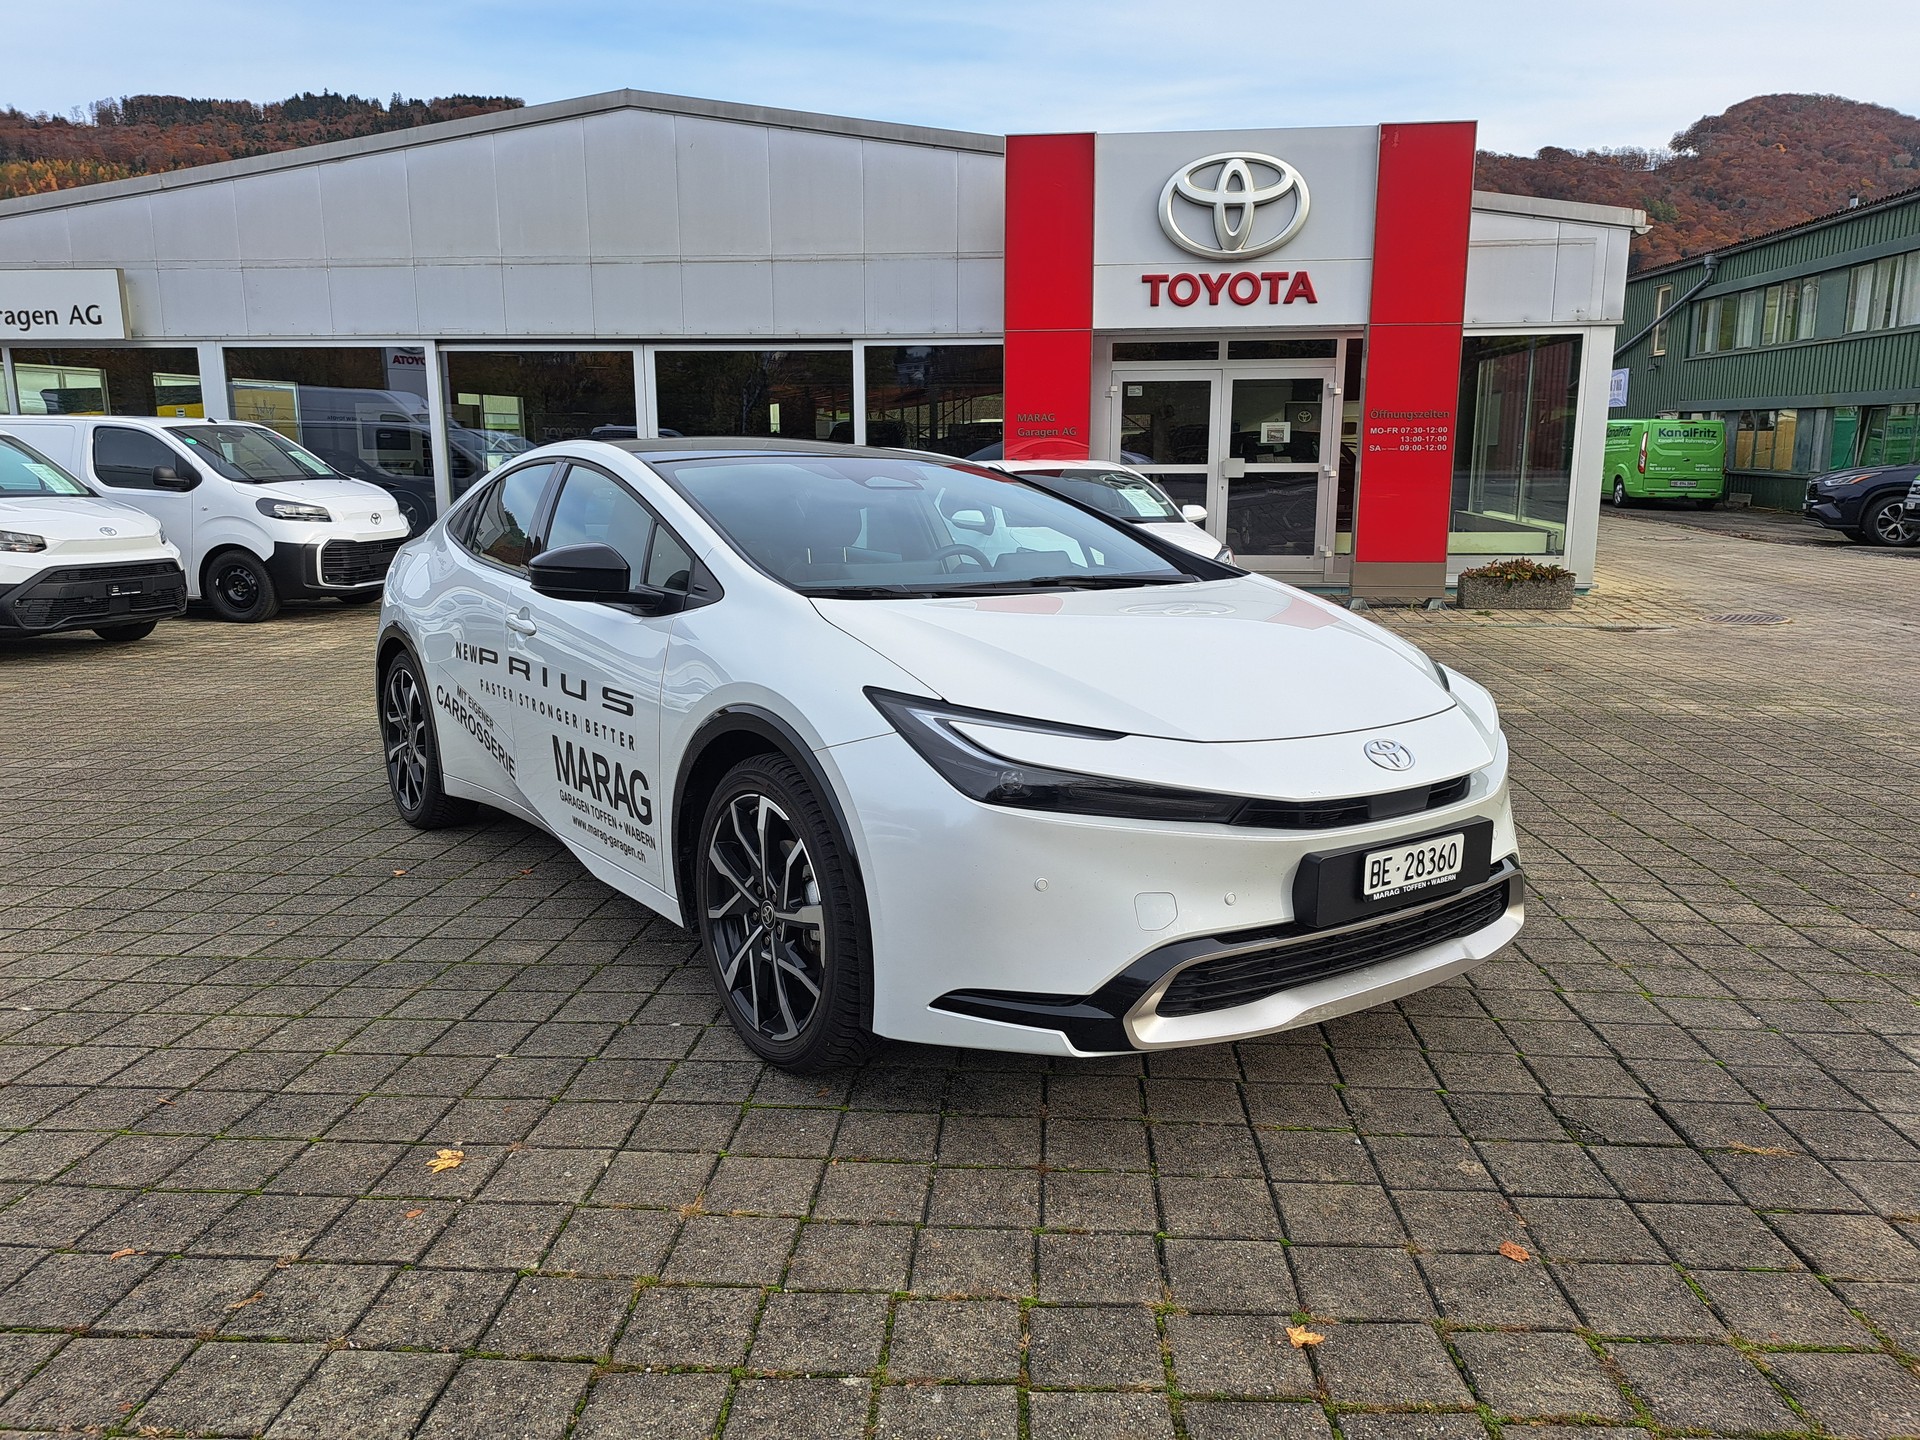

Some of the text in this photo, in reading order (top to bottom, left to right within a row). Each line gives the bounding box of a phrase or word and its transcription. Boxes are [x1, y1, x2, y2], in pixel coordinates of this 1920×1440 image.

[1141, 271, 1318, 307] TOYOTA
[69, 304, 103, 326] AG
[1017, 413, 1056, 422] MARAG
[1370, 408, 1450, 421] Öffnungszeiten
[1400, 426, 1448, 434] 07:30-12:00
[1017, 426, 1077, 438] Garagen AG
[1400, 435, 1448, 443] 13:00-17:00
[1658, 427, 1718, 438] KanalFritz
[1369, 444, 1382, 452] SA
[455, 641, 635, 717] NEW PRIUS
[456, 685, 495, 733] MIT EIGENER
[479, 678, 636, 751] FASTER STRONGER BETTER
[436, 684, 517, 781] CARROSSERIE
[552, 733, 653, 826] MARAG
[559, 788, 591, 816] GARAGEN
[590, 804, 618, 830] TOFFEN
[623, 821, 657, 851] WABERN
[571, 815, 647, 863] www.marag-garagen.ch
[1370, 842, 1457, 889] BE 28360
[1373, 887, 1400, 900] MARAG
[1403, 881, 1427, 893] TOFFEN
[1430, 873, 1457, 886] WABERN
